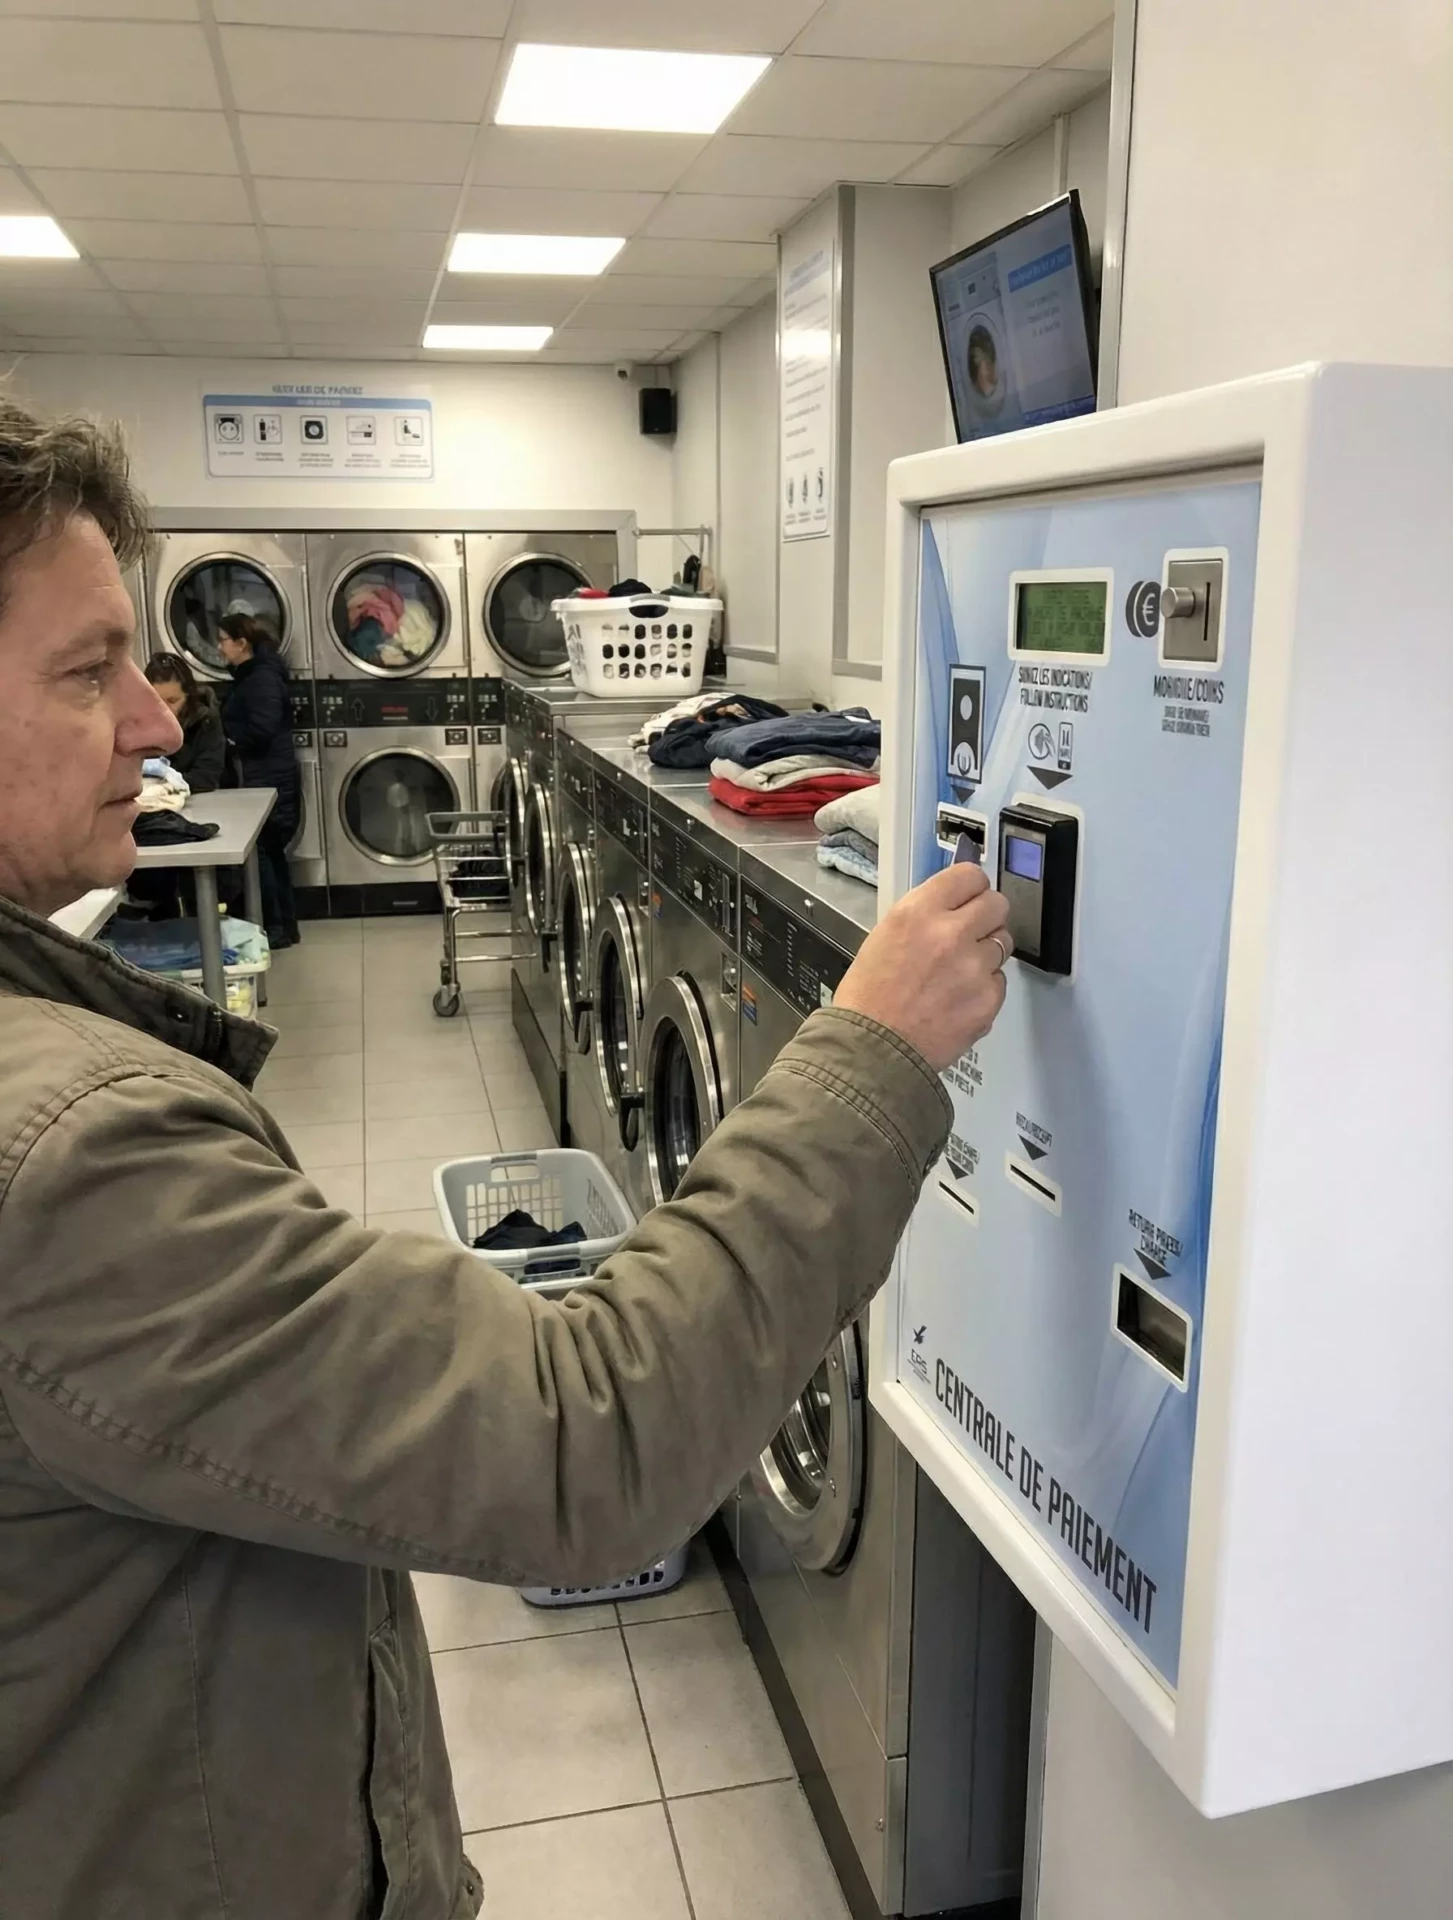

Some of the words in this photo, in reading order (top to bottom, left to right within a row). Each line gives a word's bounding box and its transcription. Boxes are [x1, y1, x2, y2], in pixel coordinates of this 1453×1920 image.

[934, 1358, 1016, 1482] CENTRALE
[1019, 1445, 1044, 1513] DE
[1047, 1475, 1157, 1635] PAIEMENT
